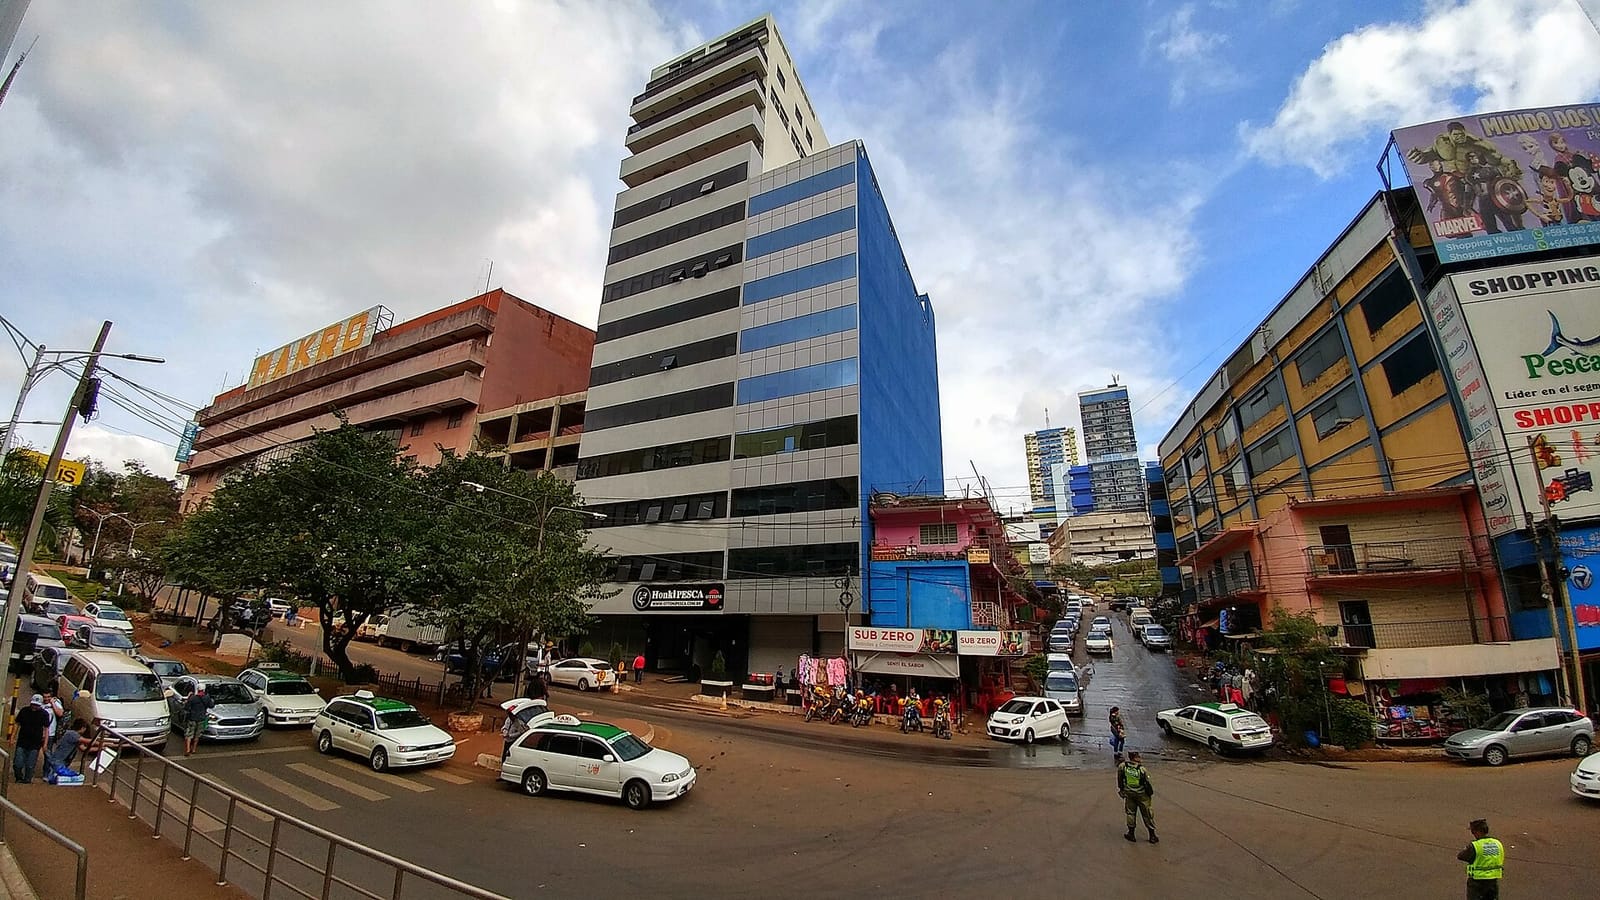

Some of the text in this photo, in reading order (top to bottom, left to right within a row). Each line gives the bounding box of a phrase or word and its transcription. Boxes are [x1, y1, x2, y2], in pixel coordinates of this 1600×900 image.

[1482, 111, 1553, 137] MUNDO
[1552, 108, 1591, 129] DOS
[1435, 216, 1482, 236] MARVEL
[1446, 238, 1493, 253] Shopping
[1449, 246, 1496, 262] Shopping
[1469, 266, 1600, 296] SHOPPING
[252, 311, 369, 386] MAKRO
[1521, 352, 1600, 379] Pesca
[1541, 388, 1556, 396] en
[1559, 385, 1570, 394] el
[854, 629, 915, 642] SUB ZERO
[976, 637, 997, 645] ZERO
